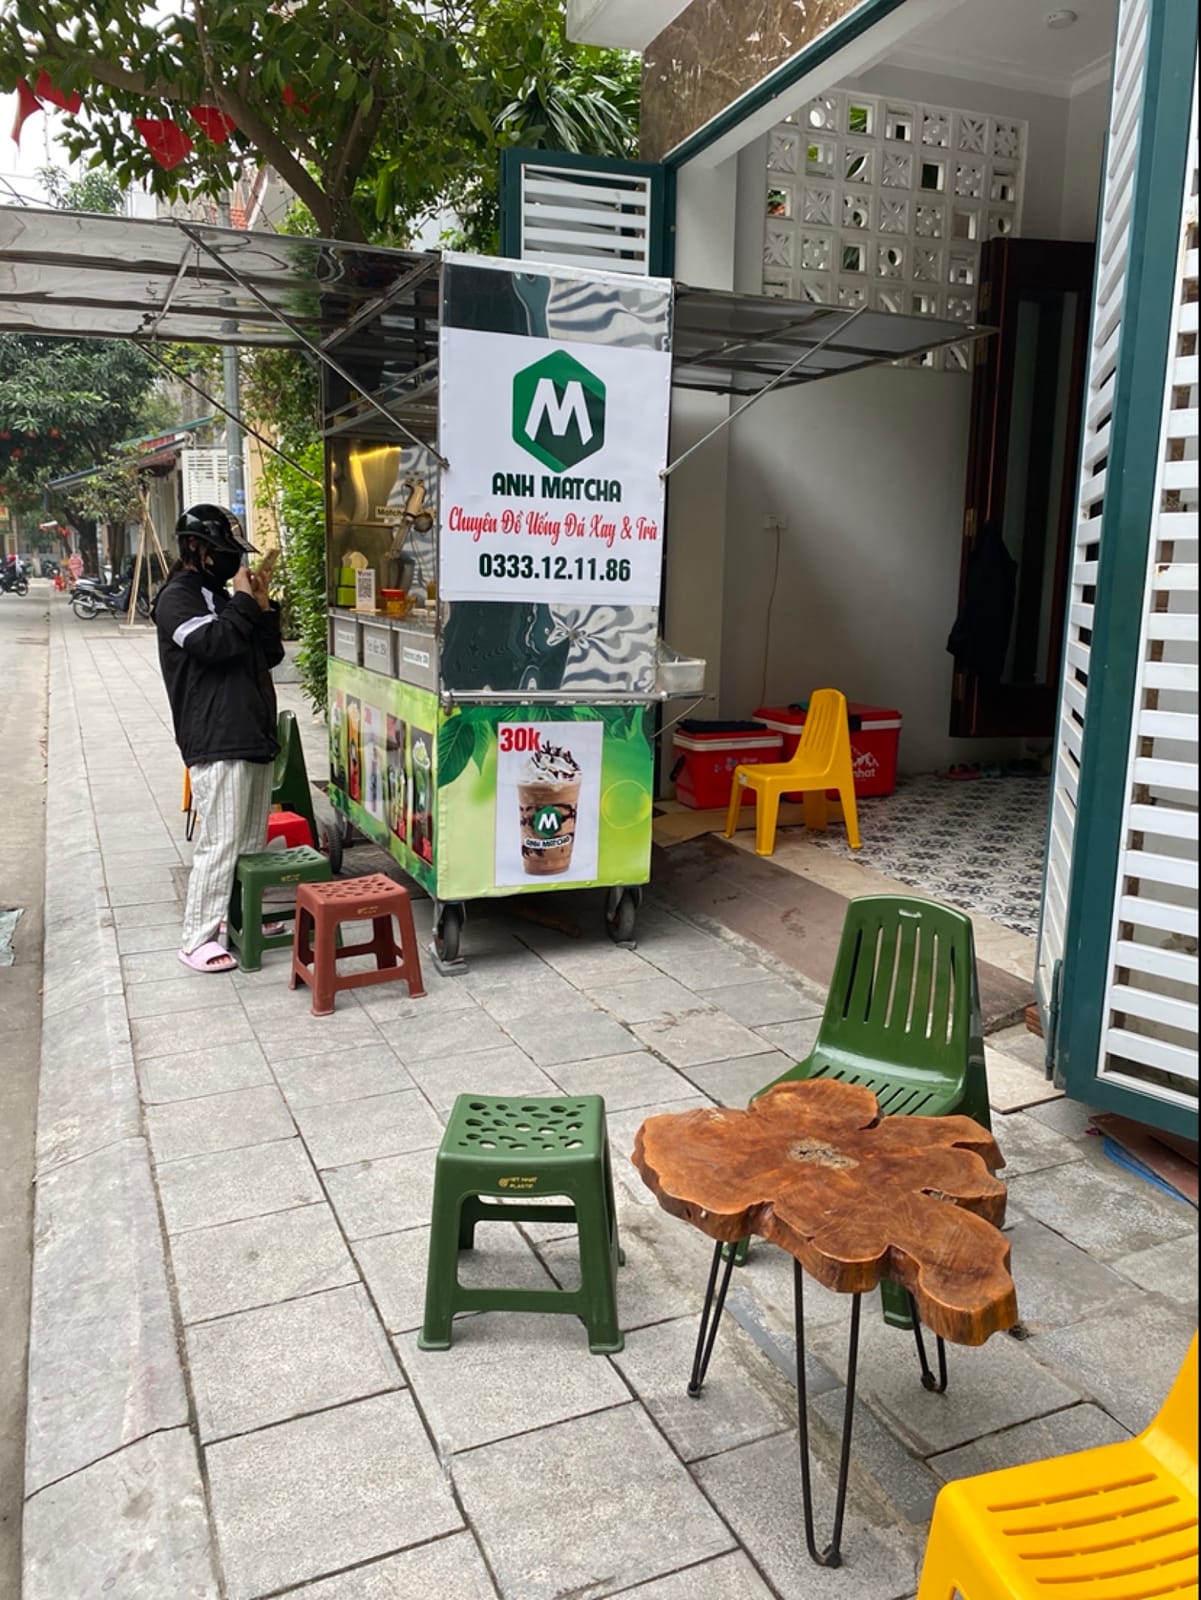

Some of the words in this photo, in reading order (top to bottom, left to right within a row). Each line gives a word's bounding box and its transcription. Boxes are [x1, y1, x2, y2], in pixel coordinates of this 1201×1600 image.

[524, 377, 593, 446] M
[492, 472, 535, 498] ANH
[541, 475, 622, 502] MATCHA
[448, 505, 497, 543] Chuyên
[501, 509, 524, 534] Đồ
[525, 511, 561, 546] Uống
[563, 512, 586, 538] Đá
[589, 513, 617, 549] Xay
[620, 515, 632, 540] &
[636, 516, 658, 541] Trà
[478, 552, 631, 582] 0333.12.11.86
[499, 727, 541, 752] 30k
[537, 813, 559, 831] M
